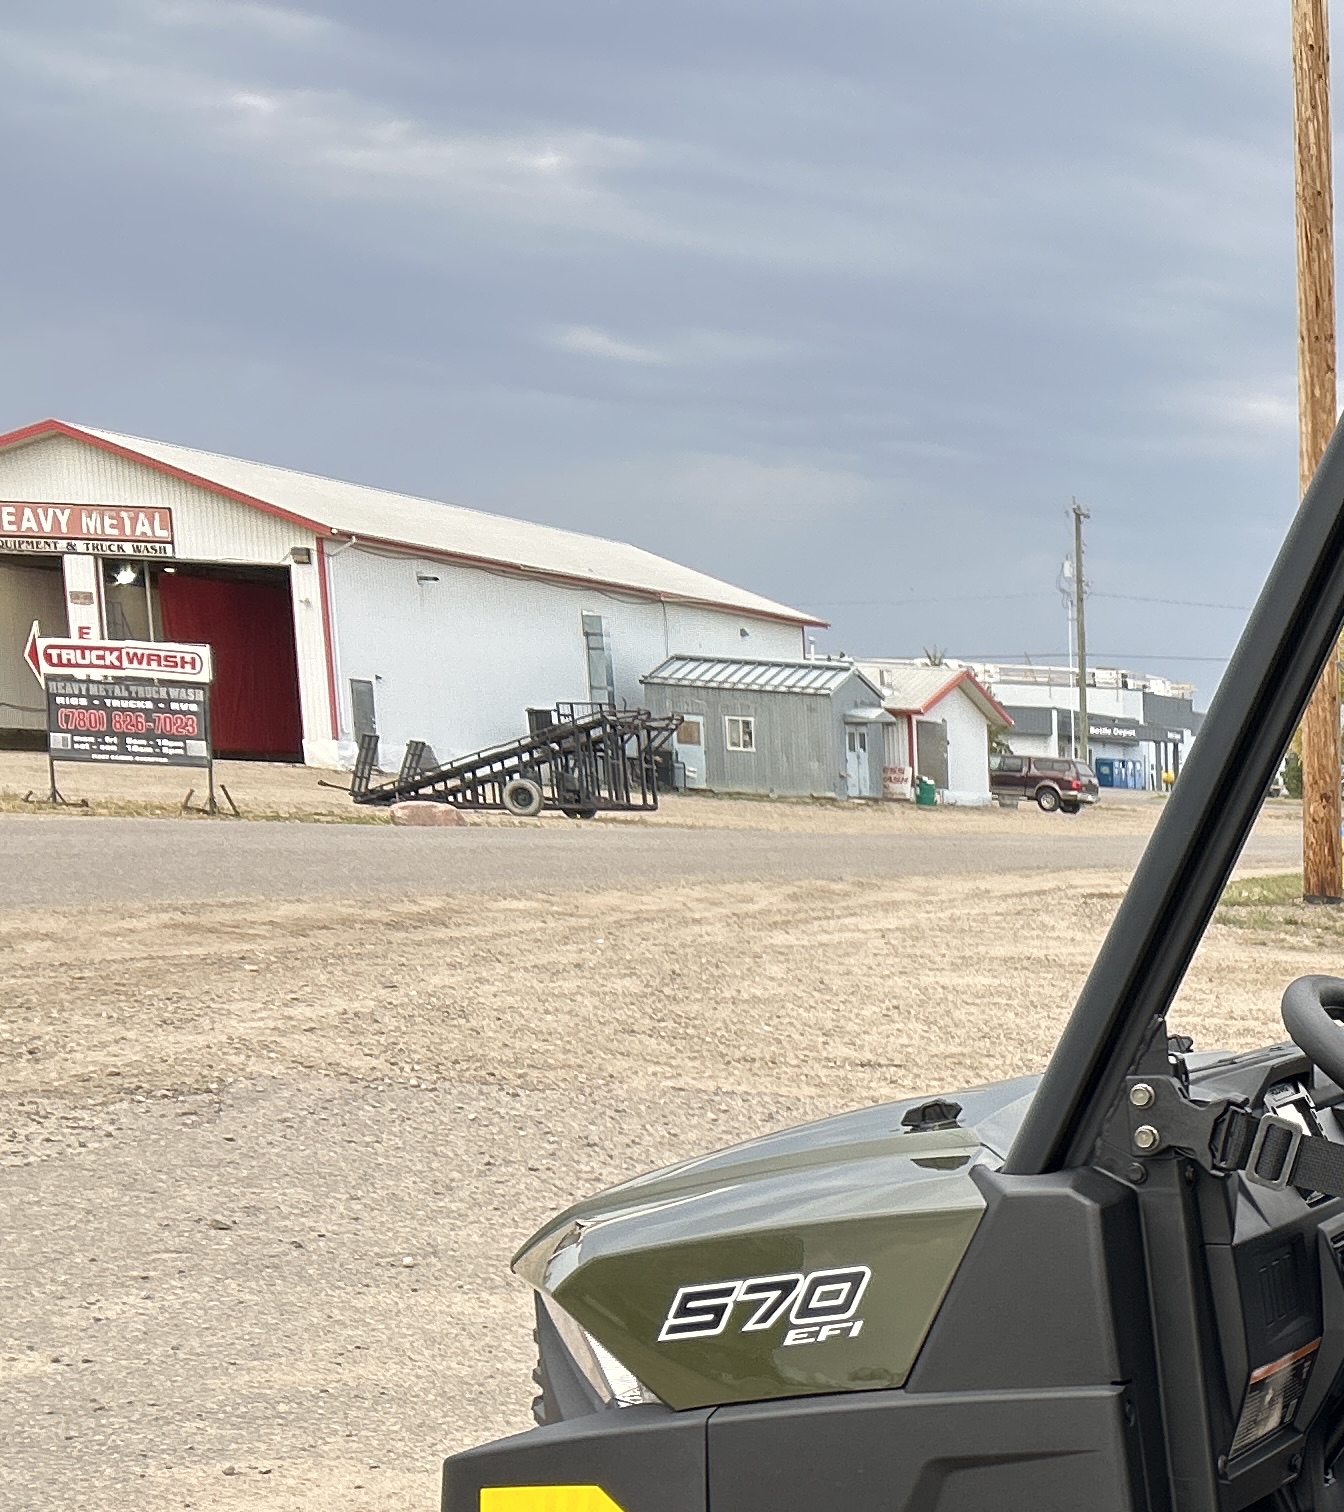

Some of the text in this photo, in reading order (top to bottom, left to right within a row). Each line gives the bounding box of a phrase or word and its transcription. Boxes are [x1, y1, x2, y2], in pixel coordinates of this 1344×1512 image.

[0, 506, 169, 537] EAVY METAL
[0, 539, 168, 555] QUIPMENT & TRUCK WASH
[46, 648, 197, 671] TRUCK WASH
[48, 680, 205, 702] HEAVY METAL TRUCK WASH
[57, 707, 198, 737] (780) 826-7023
[656, 1265, 872, 1342] 570
[783, 1319, 865, 1347] EFI
